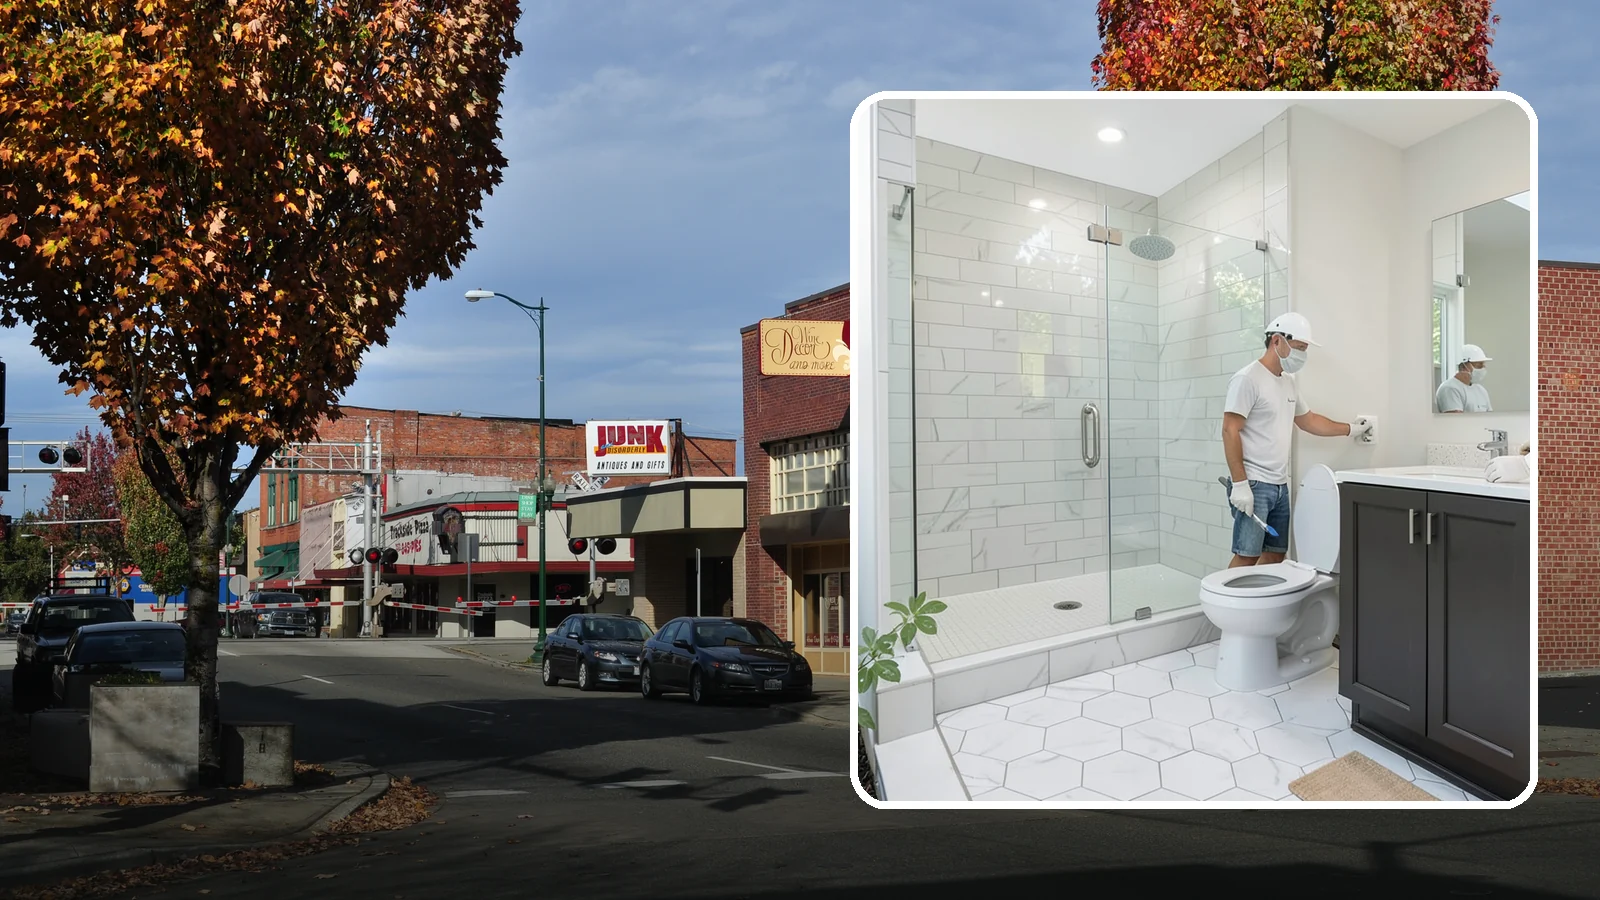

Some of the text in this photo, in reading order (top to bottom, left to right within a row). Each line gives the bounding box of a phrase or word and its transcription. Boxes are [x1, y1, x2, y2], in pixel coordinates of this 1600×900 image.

[765, 327, 831, 365] Decor
[595, 424, 665, 457] JUNK
[607, 446, 646, 454] DISORDERLY
[596, 460, 665, 470] ANTIQUES AND GIFTS
